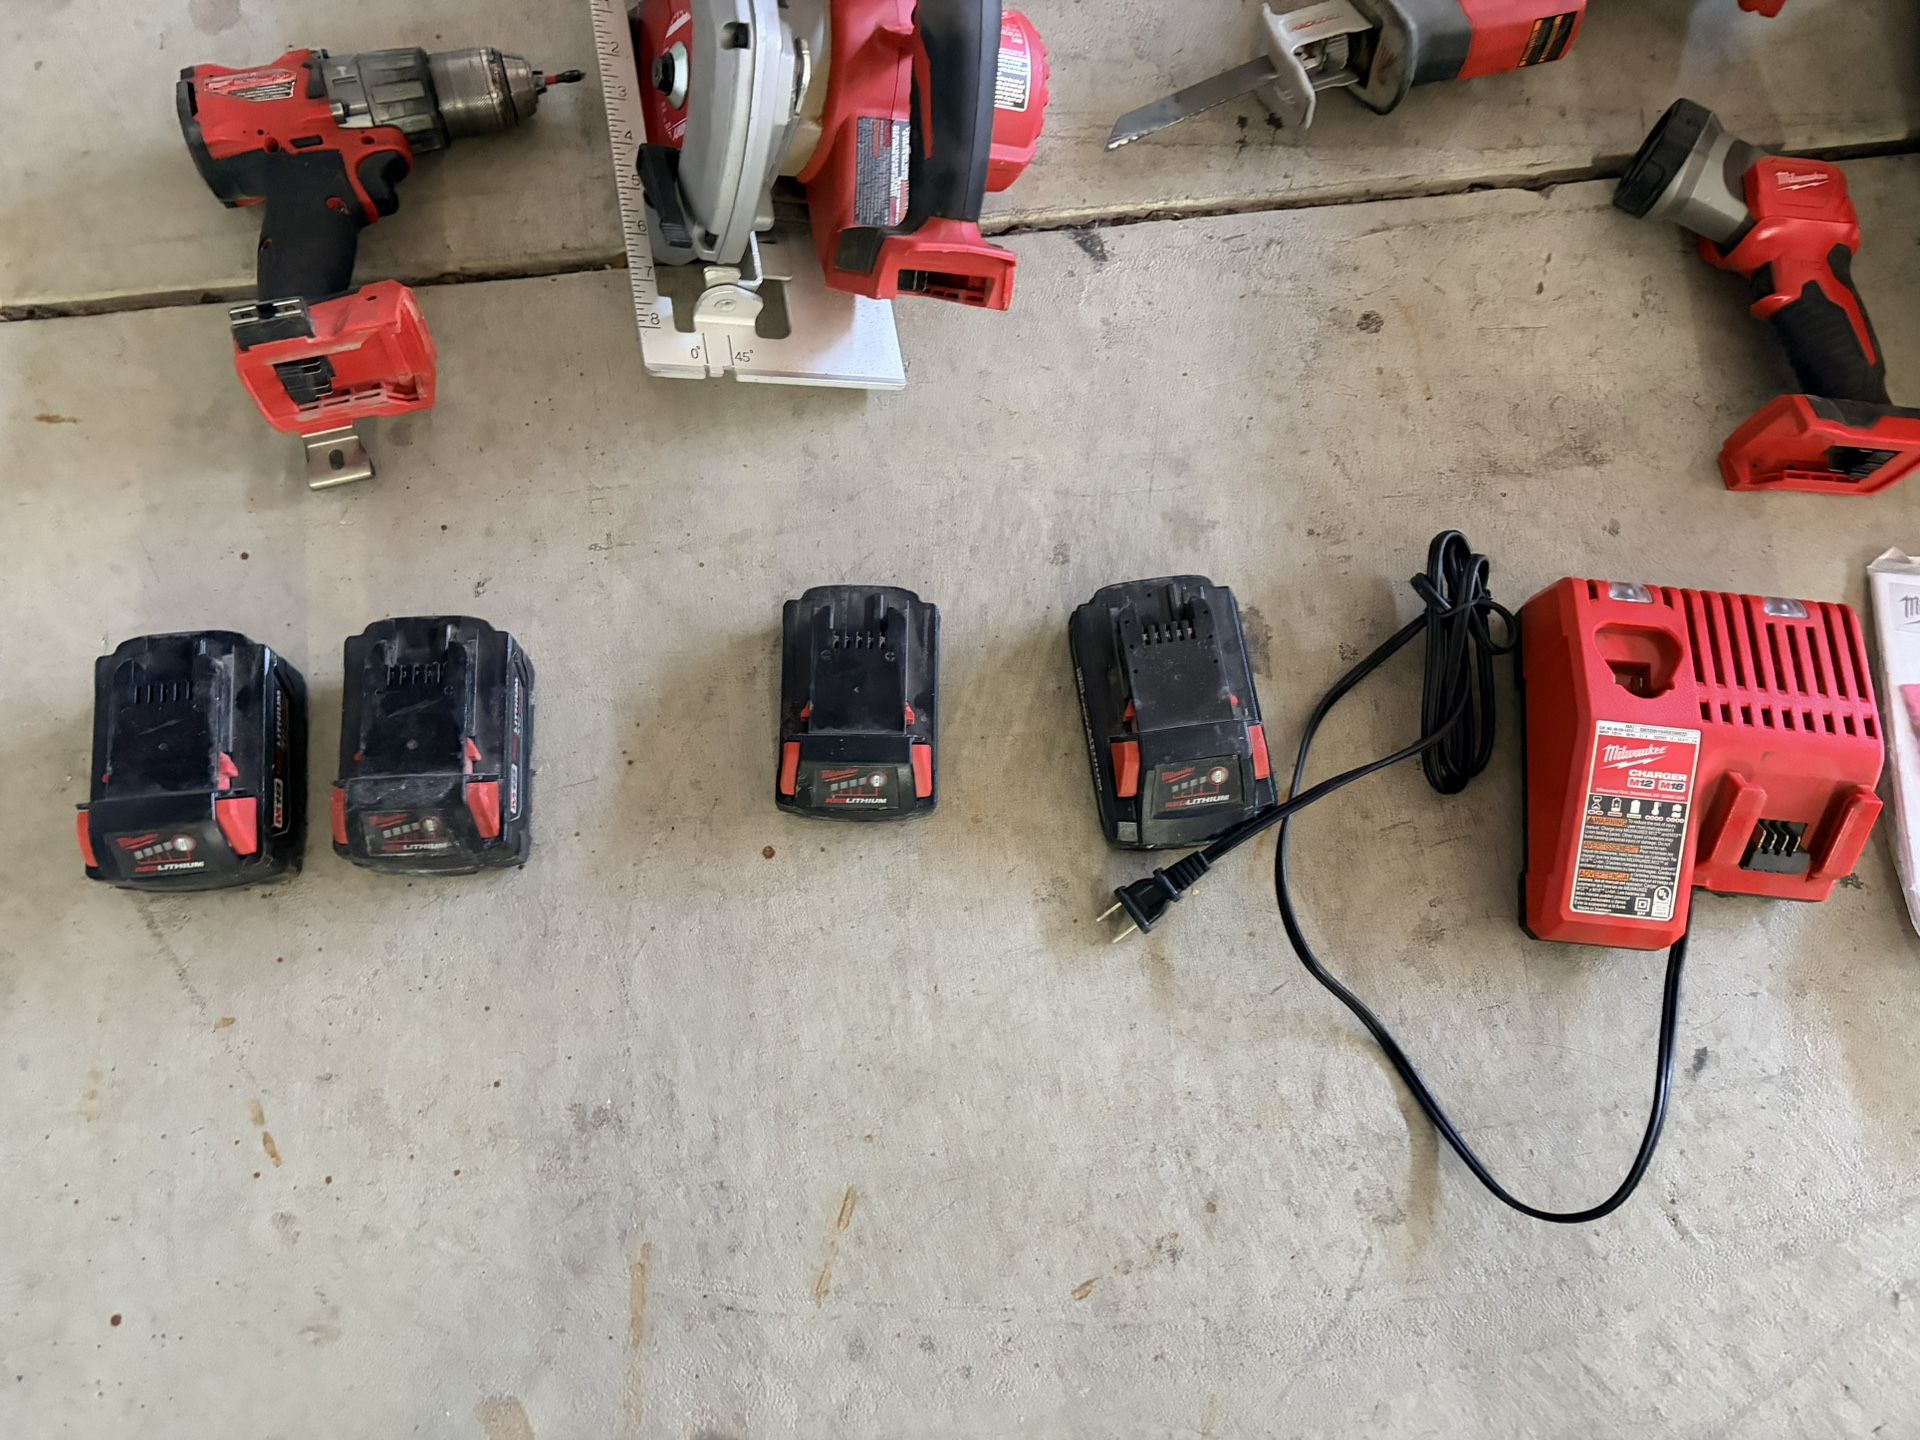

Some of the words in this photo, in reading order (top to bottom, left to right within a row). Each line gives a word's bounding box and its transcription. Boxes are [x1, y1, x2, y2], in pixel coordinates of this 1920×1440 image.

[610, 41, 619, 53] 2
[617, 86, 627, 97] 3
[624, 130, 633, 140] 4
[631, 174, 640, 187] 5
[638, 221, 647, 232] 6
[644, 266, 653, 277] 7
[650, 312, 660, 325] 8
[734, 350, 754, 363] 45°
[1602, 744, 1668, 763] Milwaukee
[1628, 768, 1688, 781] CHARGER
[1629, 778, 1654, 788] M12
[1660, 781, 1684, 791] M18
